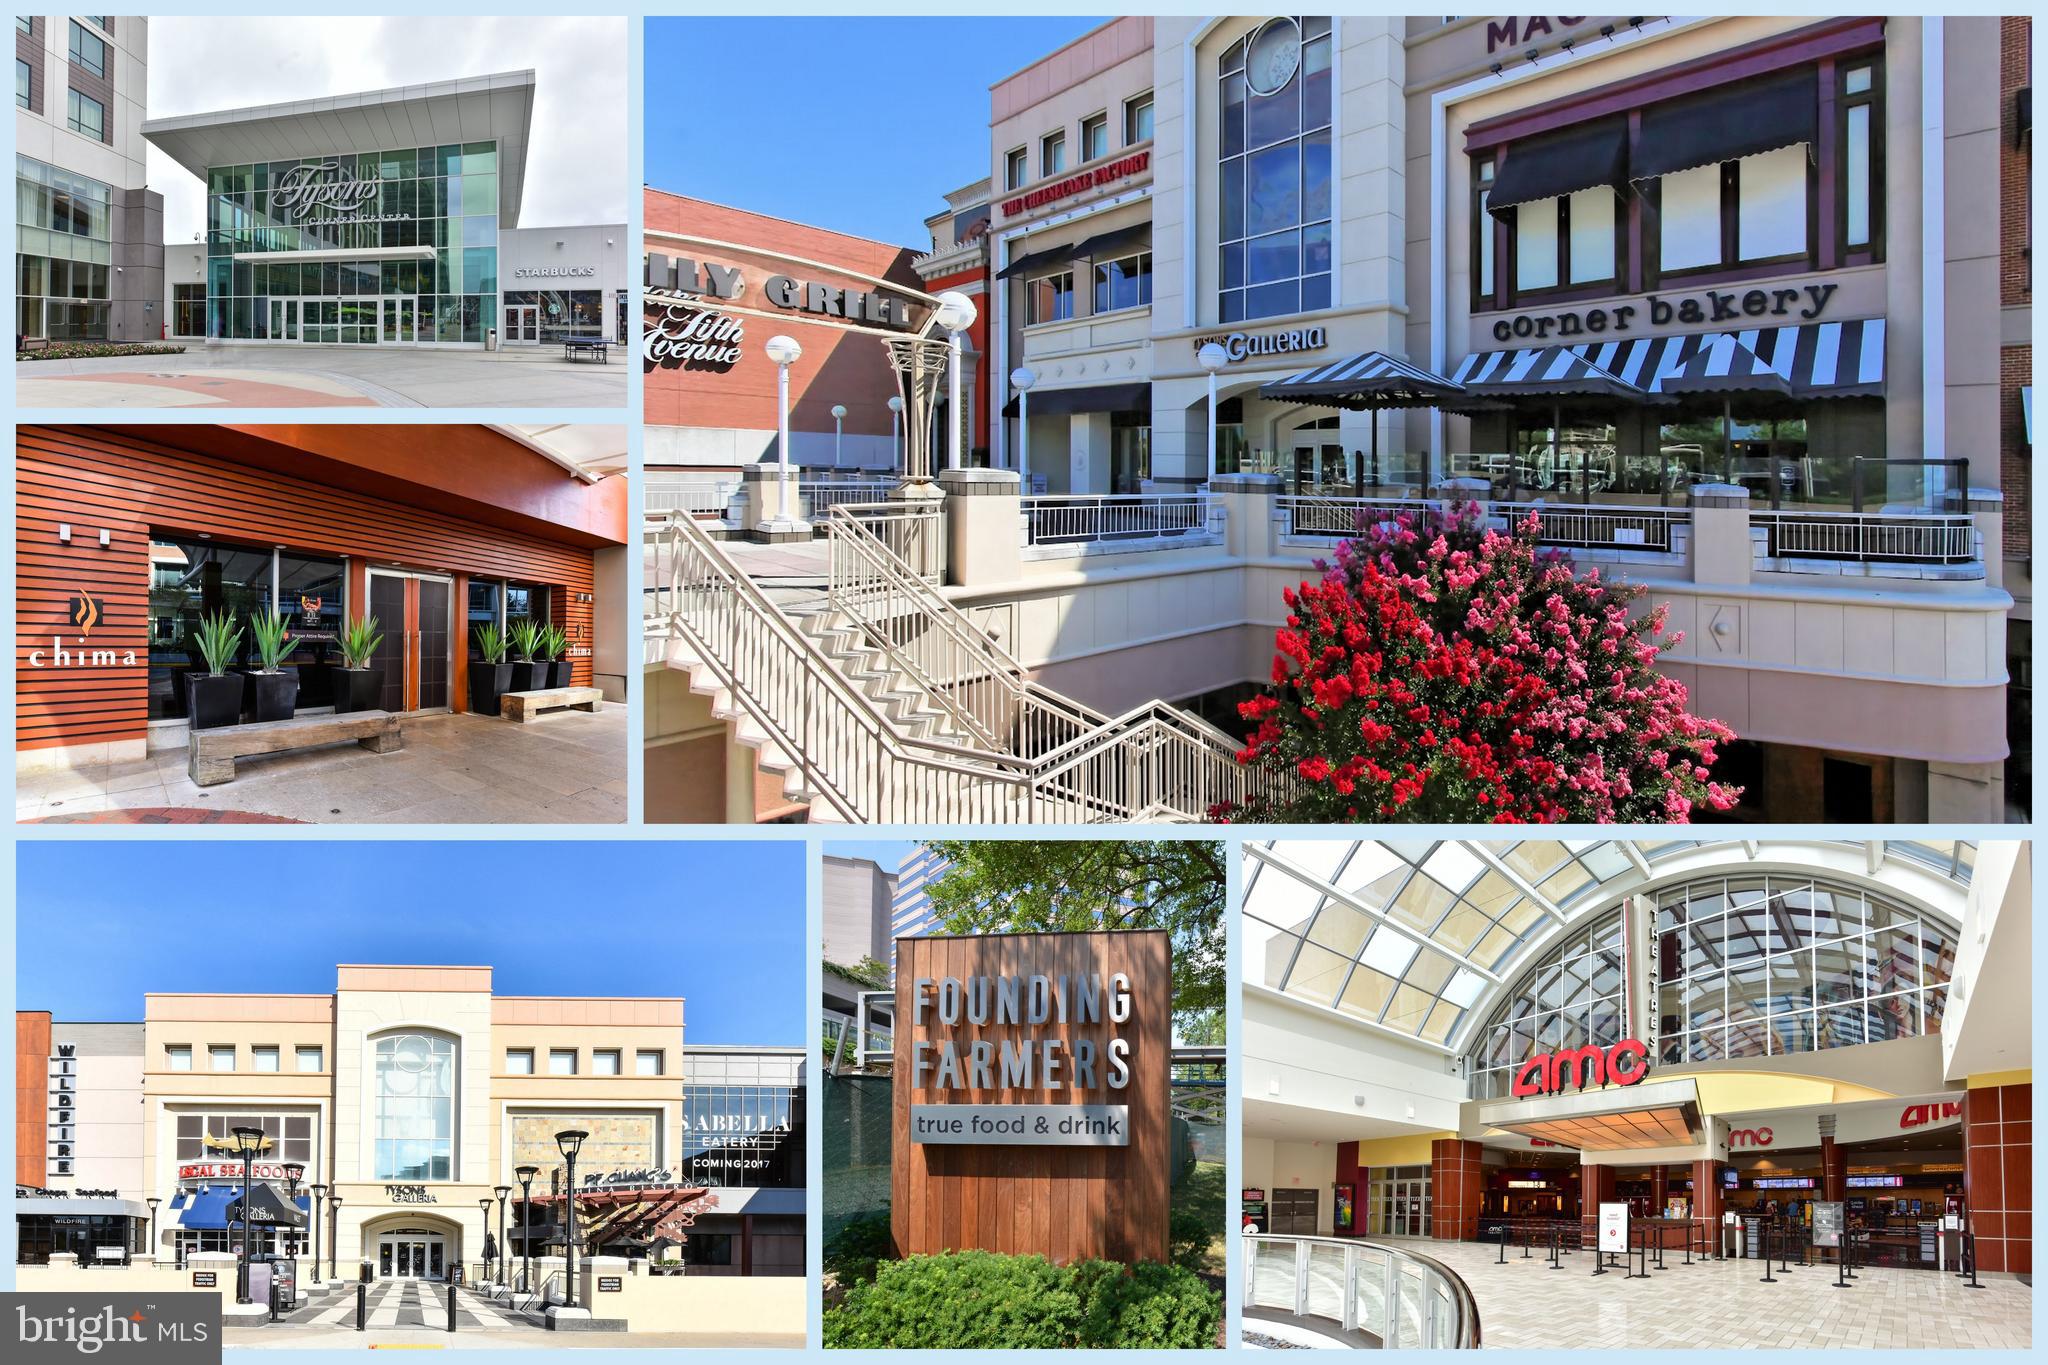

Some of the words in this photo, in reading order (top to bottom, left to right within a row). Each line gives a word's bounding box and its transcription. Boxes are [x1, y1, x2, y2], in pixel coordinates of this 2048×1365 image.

[272, 162, 377, 218] Tysons
[1001, 197, 1023, 217] THE
[1024, 172, 1093, 211] CHEESECAKE
[1093, 151, 1150, 186] FACTORY
[515, 266, 595, 278] STARBUCKS
[1492, 304, 1635, 342] corner
[1647, 283, 1839, 325] bakery
[666, 305, 745, 345] Fifth
[29, 635, 137, 667] chima
[568, 643, 592, 656] chima
[1649, 909, 1659, 1048] THEATRES
[913, 972, 1131, 1027] FOUNDING
[912, 1038, 1130, 1090] FARMERS
[56, 1044, 76, 1173] WILDFIRE
[917, 1116, 963, 1134] true
[971, 1115, 1025, 1134] food
[1034, 1116, 1049, 1134] &
[1058, 1115, 1121, 1135] drink
[702, 1136, 759, 1147] EATERY
[219, 1164, 245, 1178] SEA
[693, 1158, 741, 1168] COMING
[743, 1159, 770, 1169] 2017
[384, 1185, 426, 1195] TYSONS
[567, 1187, 615, 1195] HINA
[629, 1183, 693, 1192] BISTRO
[392, 1194, 438, 1203] GALLERIA
[235, 1206, 267, 1214] TYONS
[240, 1213, 275, 1221] GLLERIA
